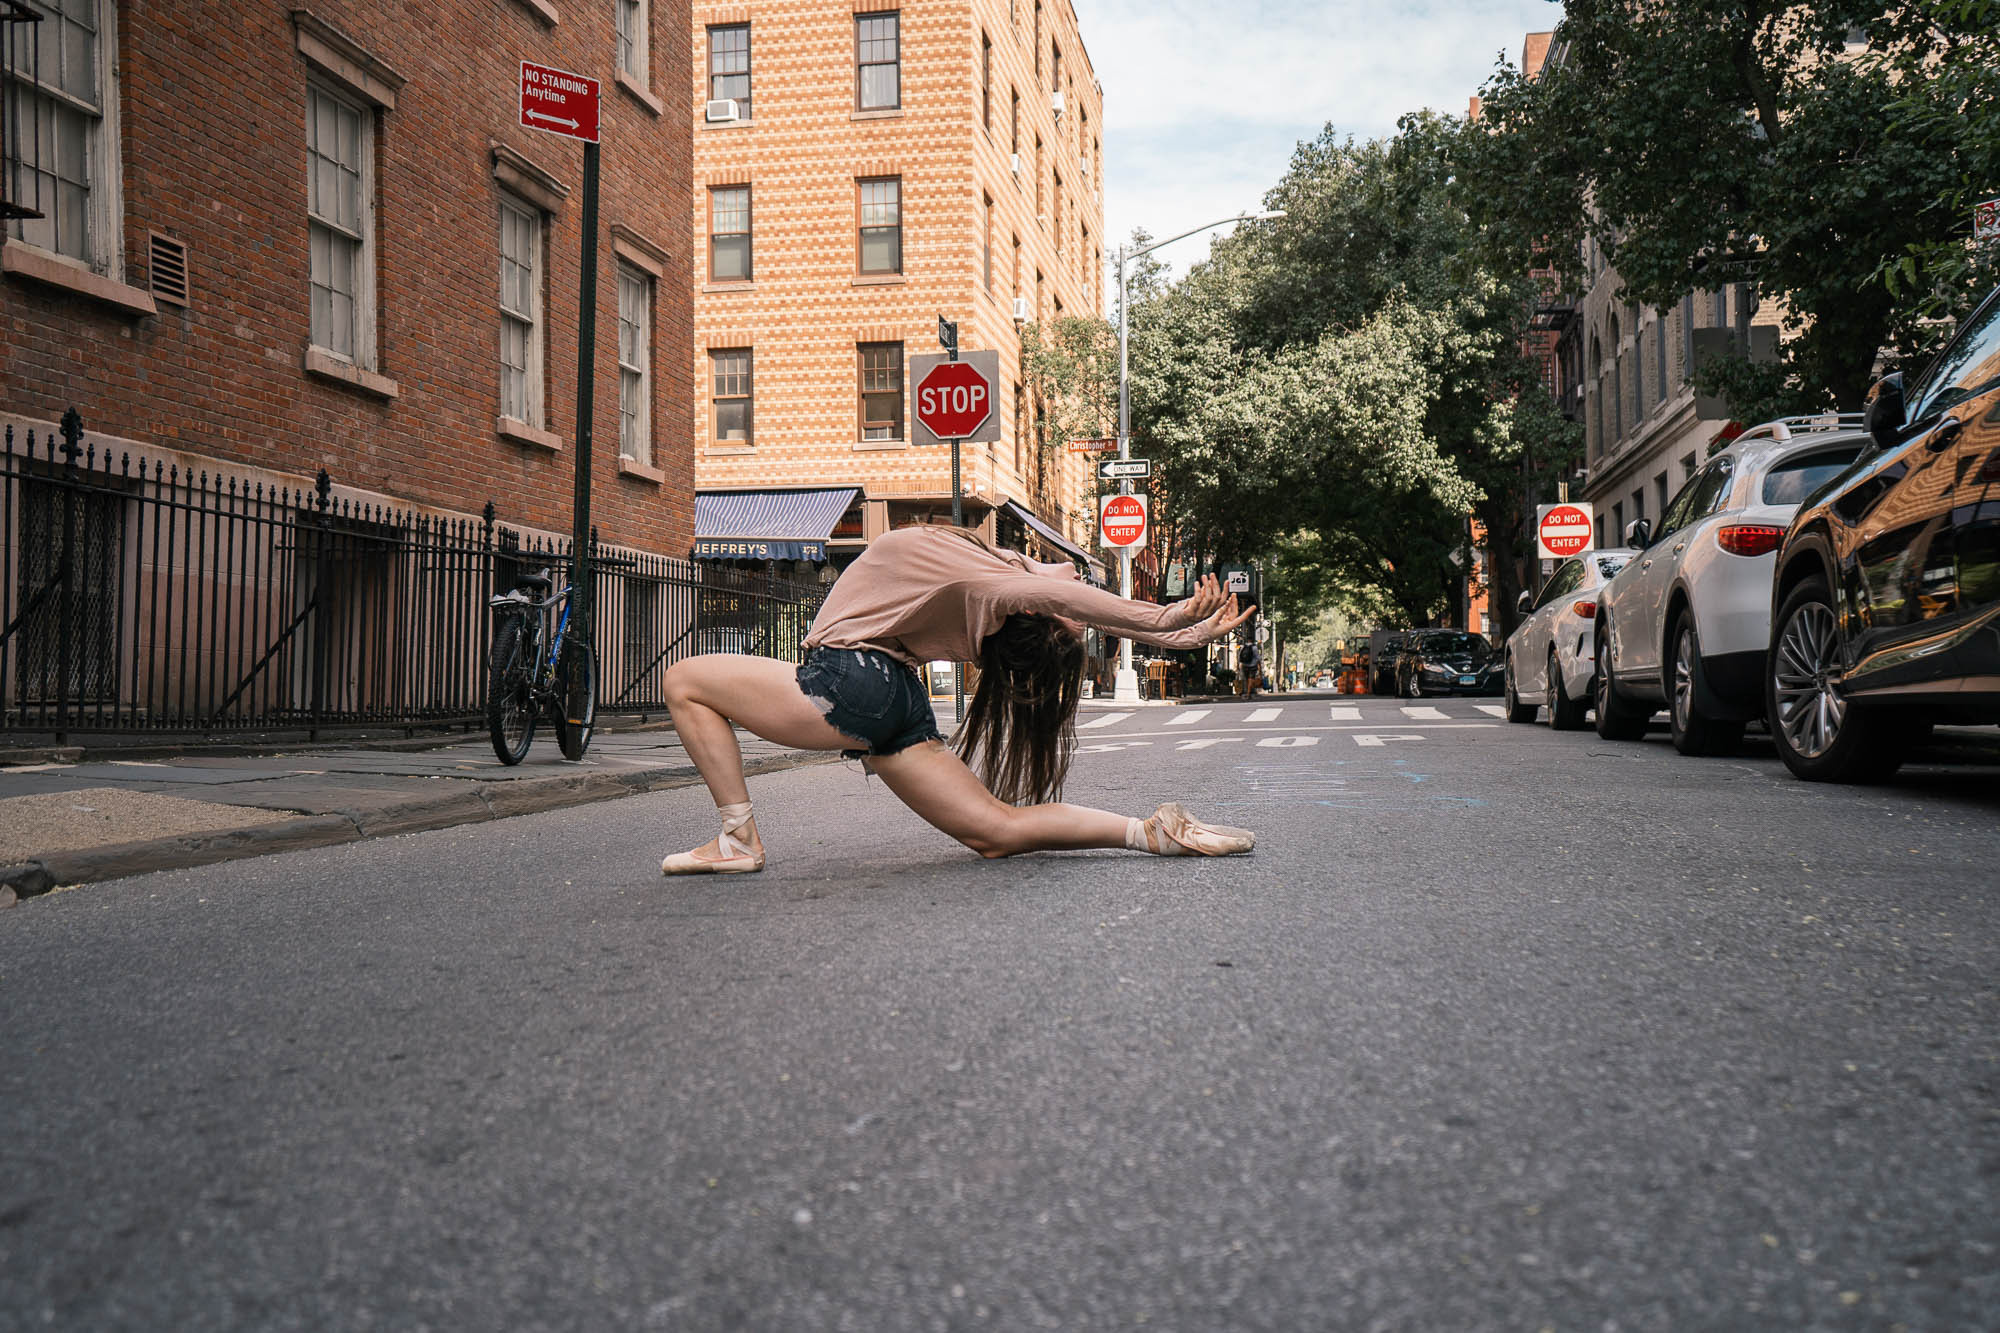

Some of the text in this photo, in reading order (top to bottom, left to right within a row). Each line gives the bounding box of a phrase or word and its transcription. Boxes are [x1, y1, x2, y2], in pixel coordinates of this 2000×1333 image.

[525, 69, 588, 96] NO STANDING
[525, 84, 566, 104] Anytime
[921, 385, 986, 415] STOP
[1069, 440, 1106, 451] Christopher
[1113, 464, 1144, 473] ONE WAY
[1108, 505, 1139, 515] DO NOT
[1549, 514, 1581, 524] DO NOT
[1110, 527, 1136, 537] ENTER
[1551, 538, 1581, 548] ENTER
[695, 543, 818, 555] JEFFREY'S 172
[1068, 734, 1426, 754] STOP
